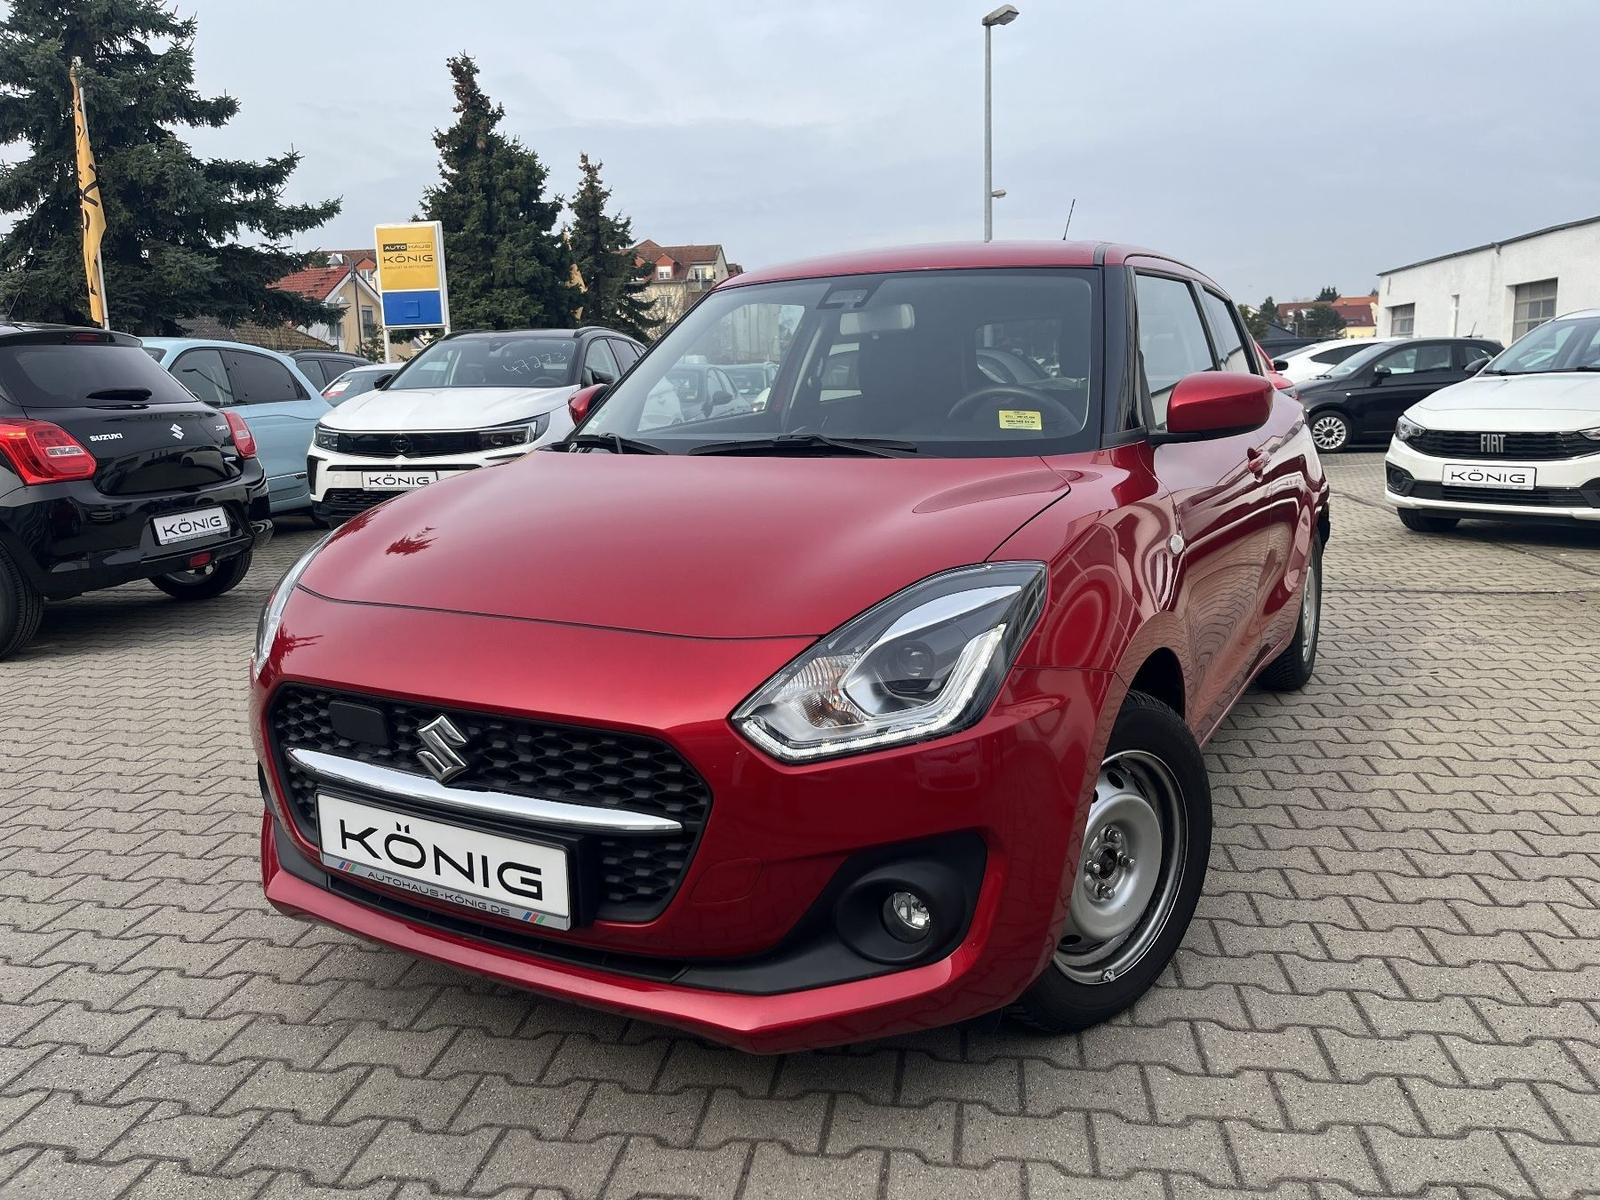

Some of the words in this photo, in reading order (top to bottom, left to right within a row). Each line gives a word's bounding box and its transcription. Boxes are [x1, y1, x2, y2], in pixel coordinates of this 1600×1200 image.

[383, 253, 433, 263] KÖNIG
[89, 432, 123, 442] SUZUKI
[1480, 433, 1506, 453] FIAT
[368, 473, 430, 486] KÖNIG
[1450, 468, 1526, 484] KÖNIG
[163, 516, 222, 537] KÖNIG
[339, 819, 543, 901] KÖNIG
[367, 871, 510, 917] AUTOHAUS-KÖNIG.DE
